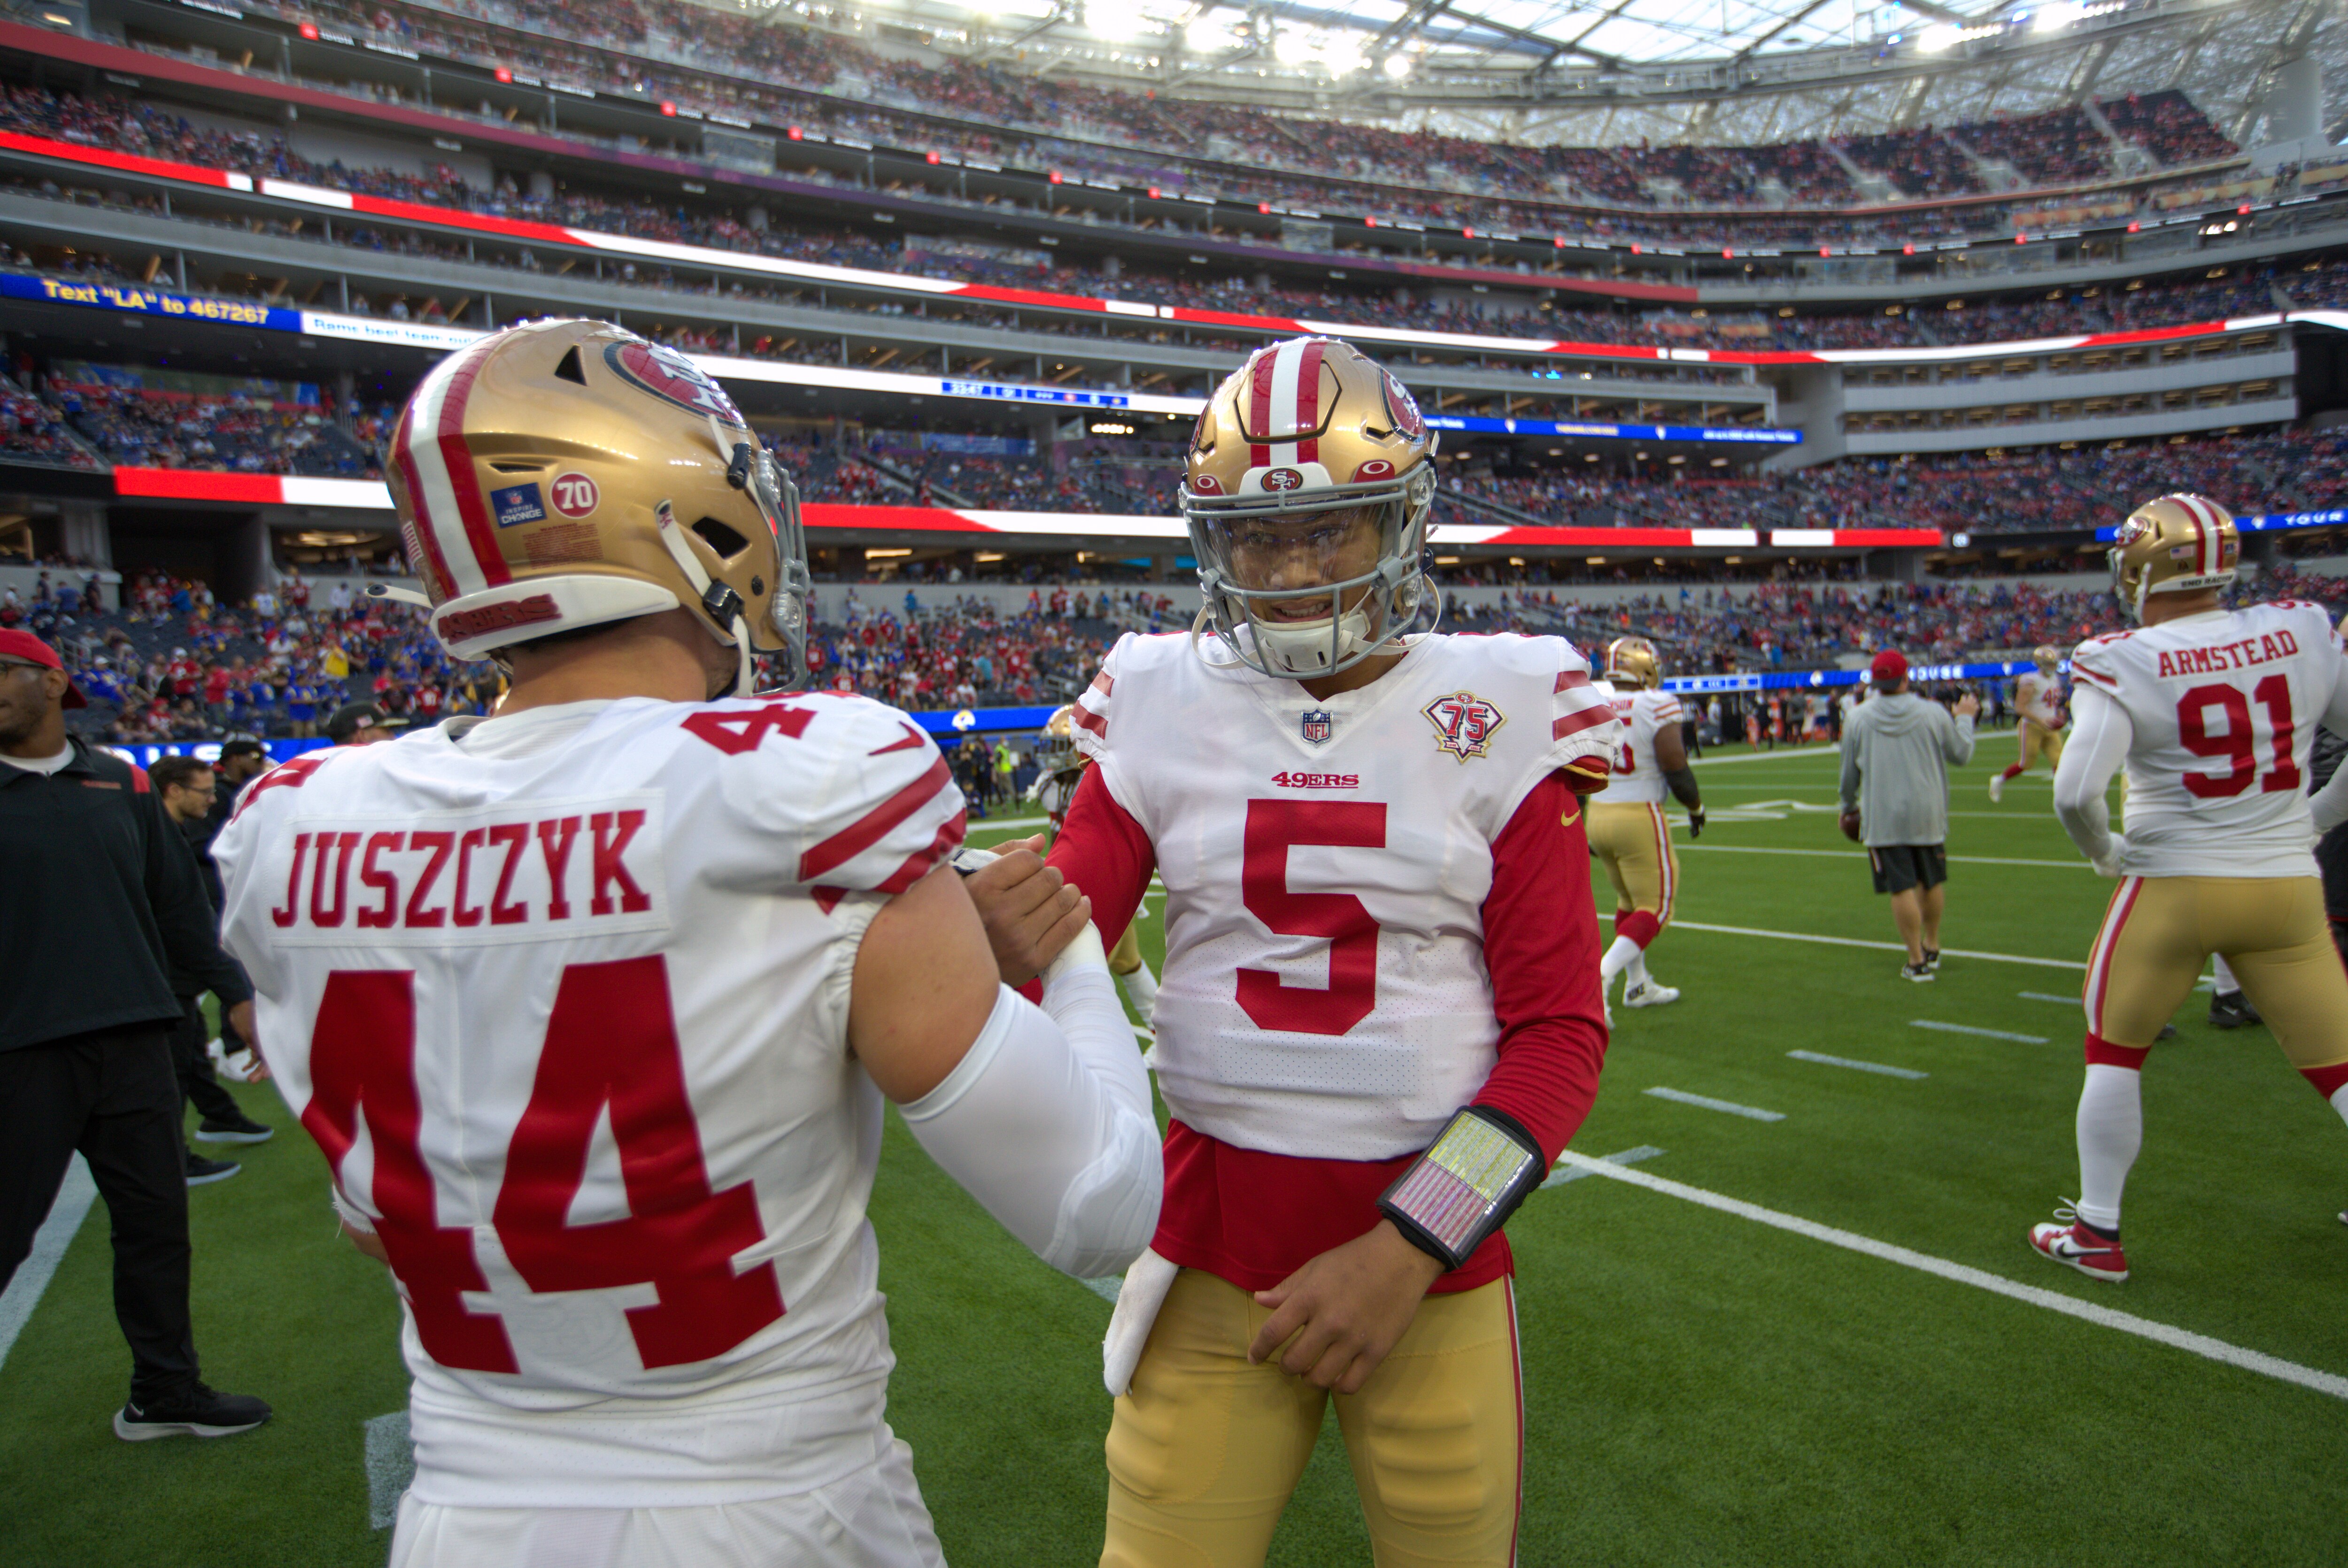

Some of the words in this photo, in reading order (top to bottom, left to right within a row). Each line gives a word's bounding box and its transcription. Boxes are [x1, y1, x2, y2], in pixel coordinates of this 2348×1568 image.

[44, 278, 99, 303] Text
[100, 286, 157, 309] "LA"
[161, 294, 186, 314] to
[188, 298, 270, 324] 467267
[506, 504, 533, 515] INSPIRE
[557, 481, 594, 509] 70
[501, 509, 543, 524] CHANGE
[541, 523, 578, 532] WARNING
[2285, 508, 2345, 526] YOUR
[2159, 630, 2299, 678] ARMSTEAD
[1305, 724, 1328, 740] NFL
[1443, 704, 1486, 743] 75
[2176, 674, 2300, 798] 91
[1271, 772, 1359, 789] 49ERS
[272, 809, 652, 929] JUSZCZYK
[1235, 799, 1387, 1036] 5
[301, 954, 787, 1375] 44
